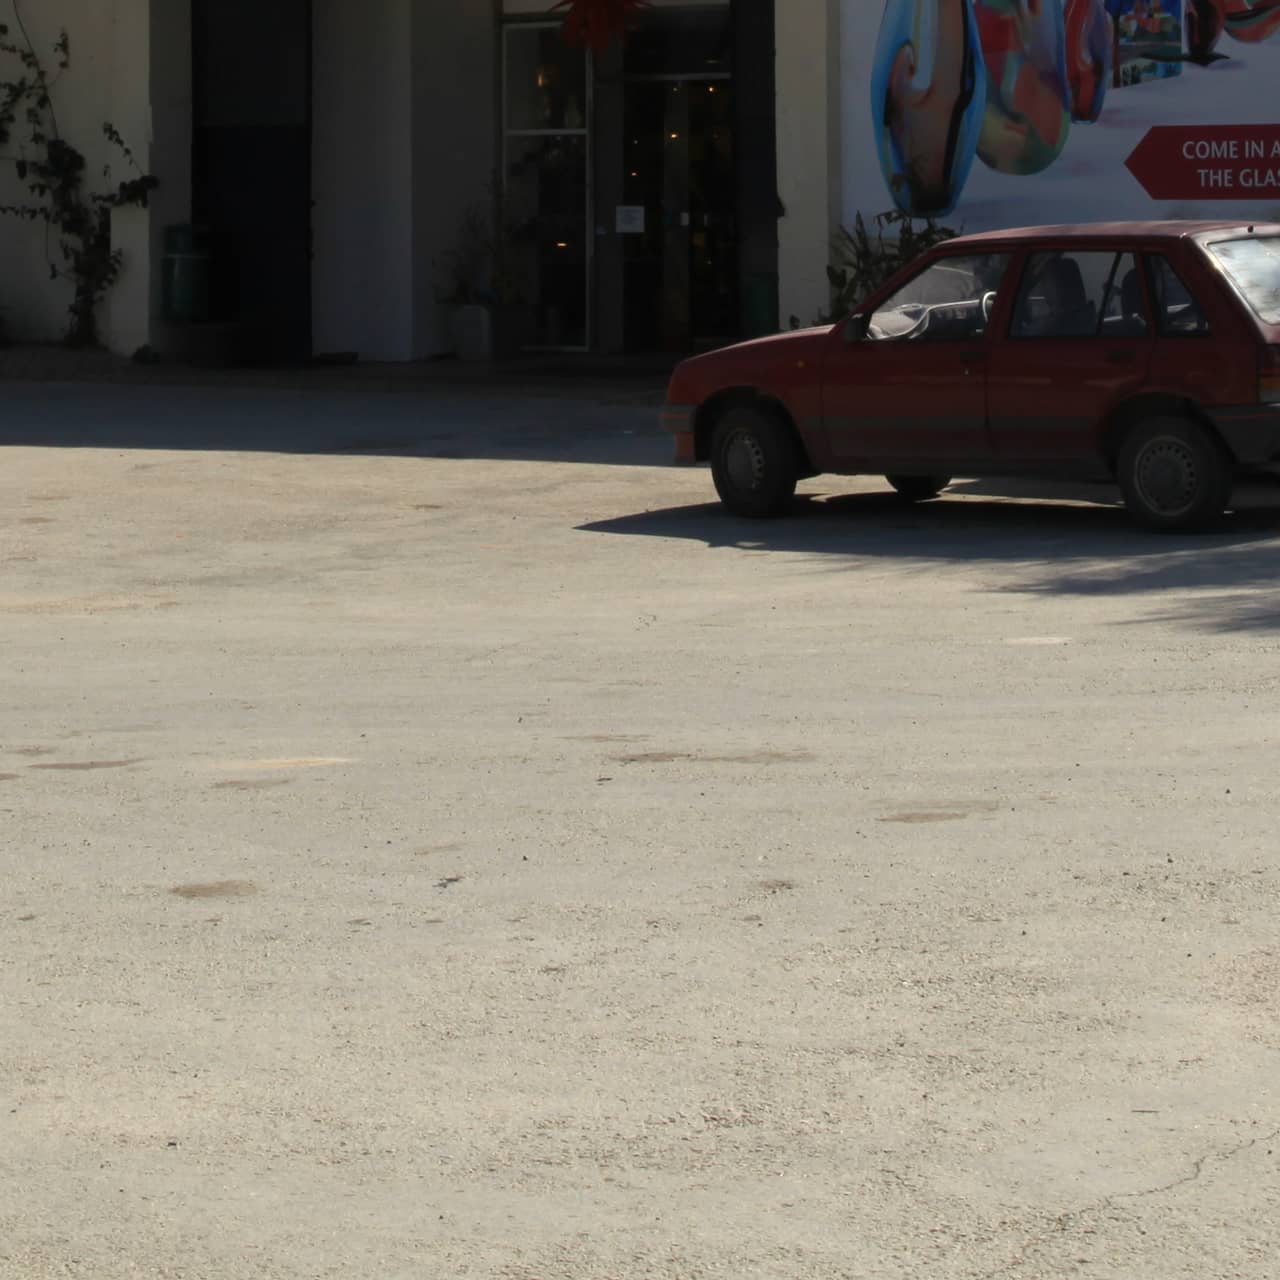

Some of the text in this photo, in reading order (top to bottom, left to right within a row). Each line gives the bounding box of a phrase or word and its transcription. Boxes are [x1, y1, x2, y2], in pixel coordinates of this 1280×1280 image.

[1182, 140, 1238, 159] COME
[1245, 140, 1264, 158] IN
[1198, 169, 1233, 187] THE
